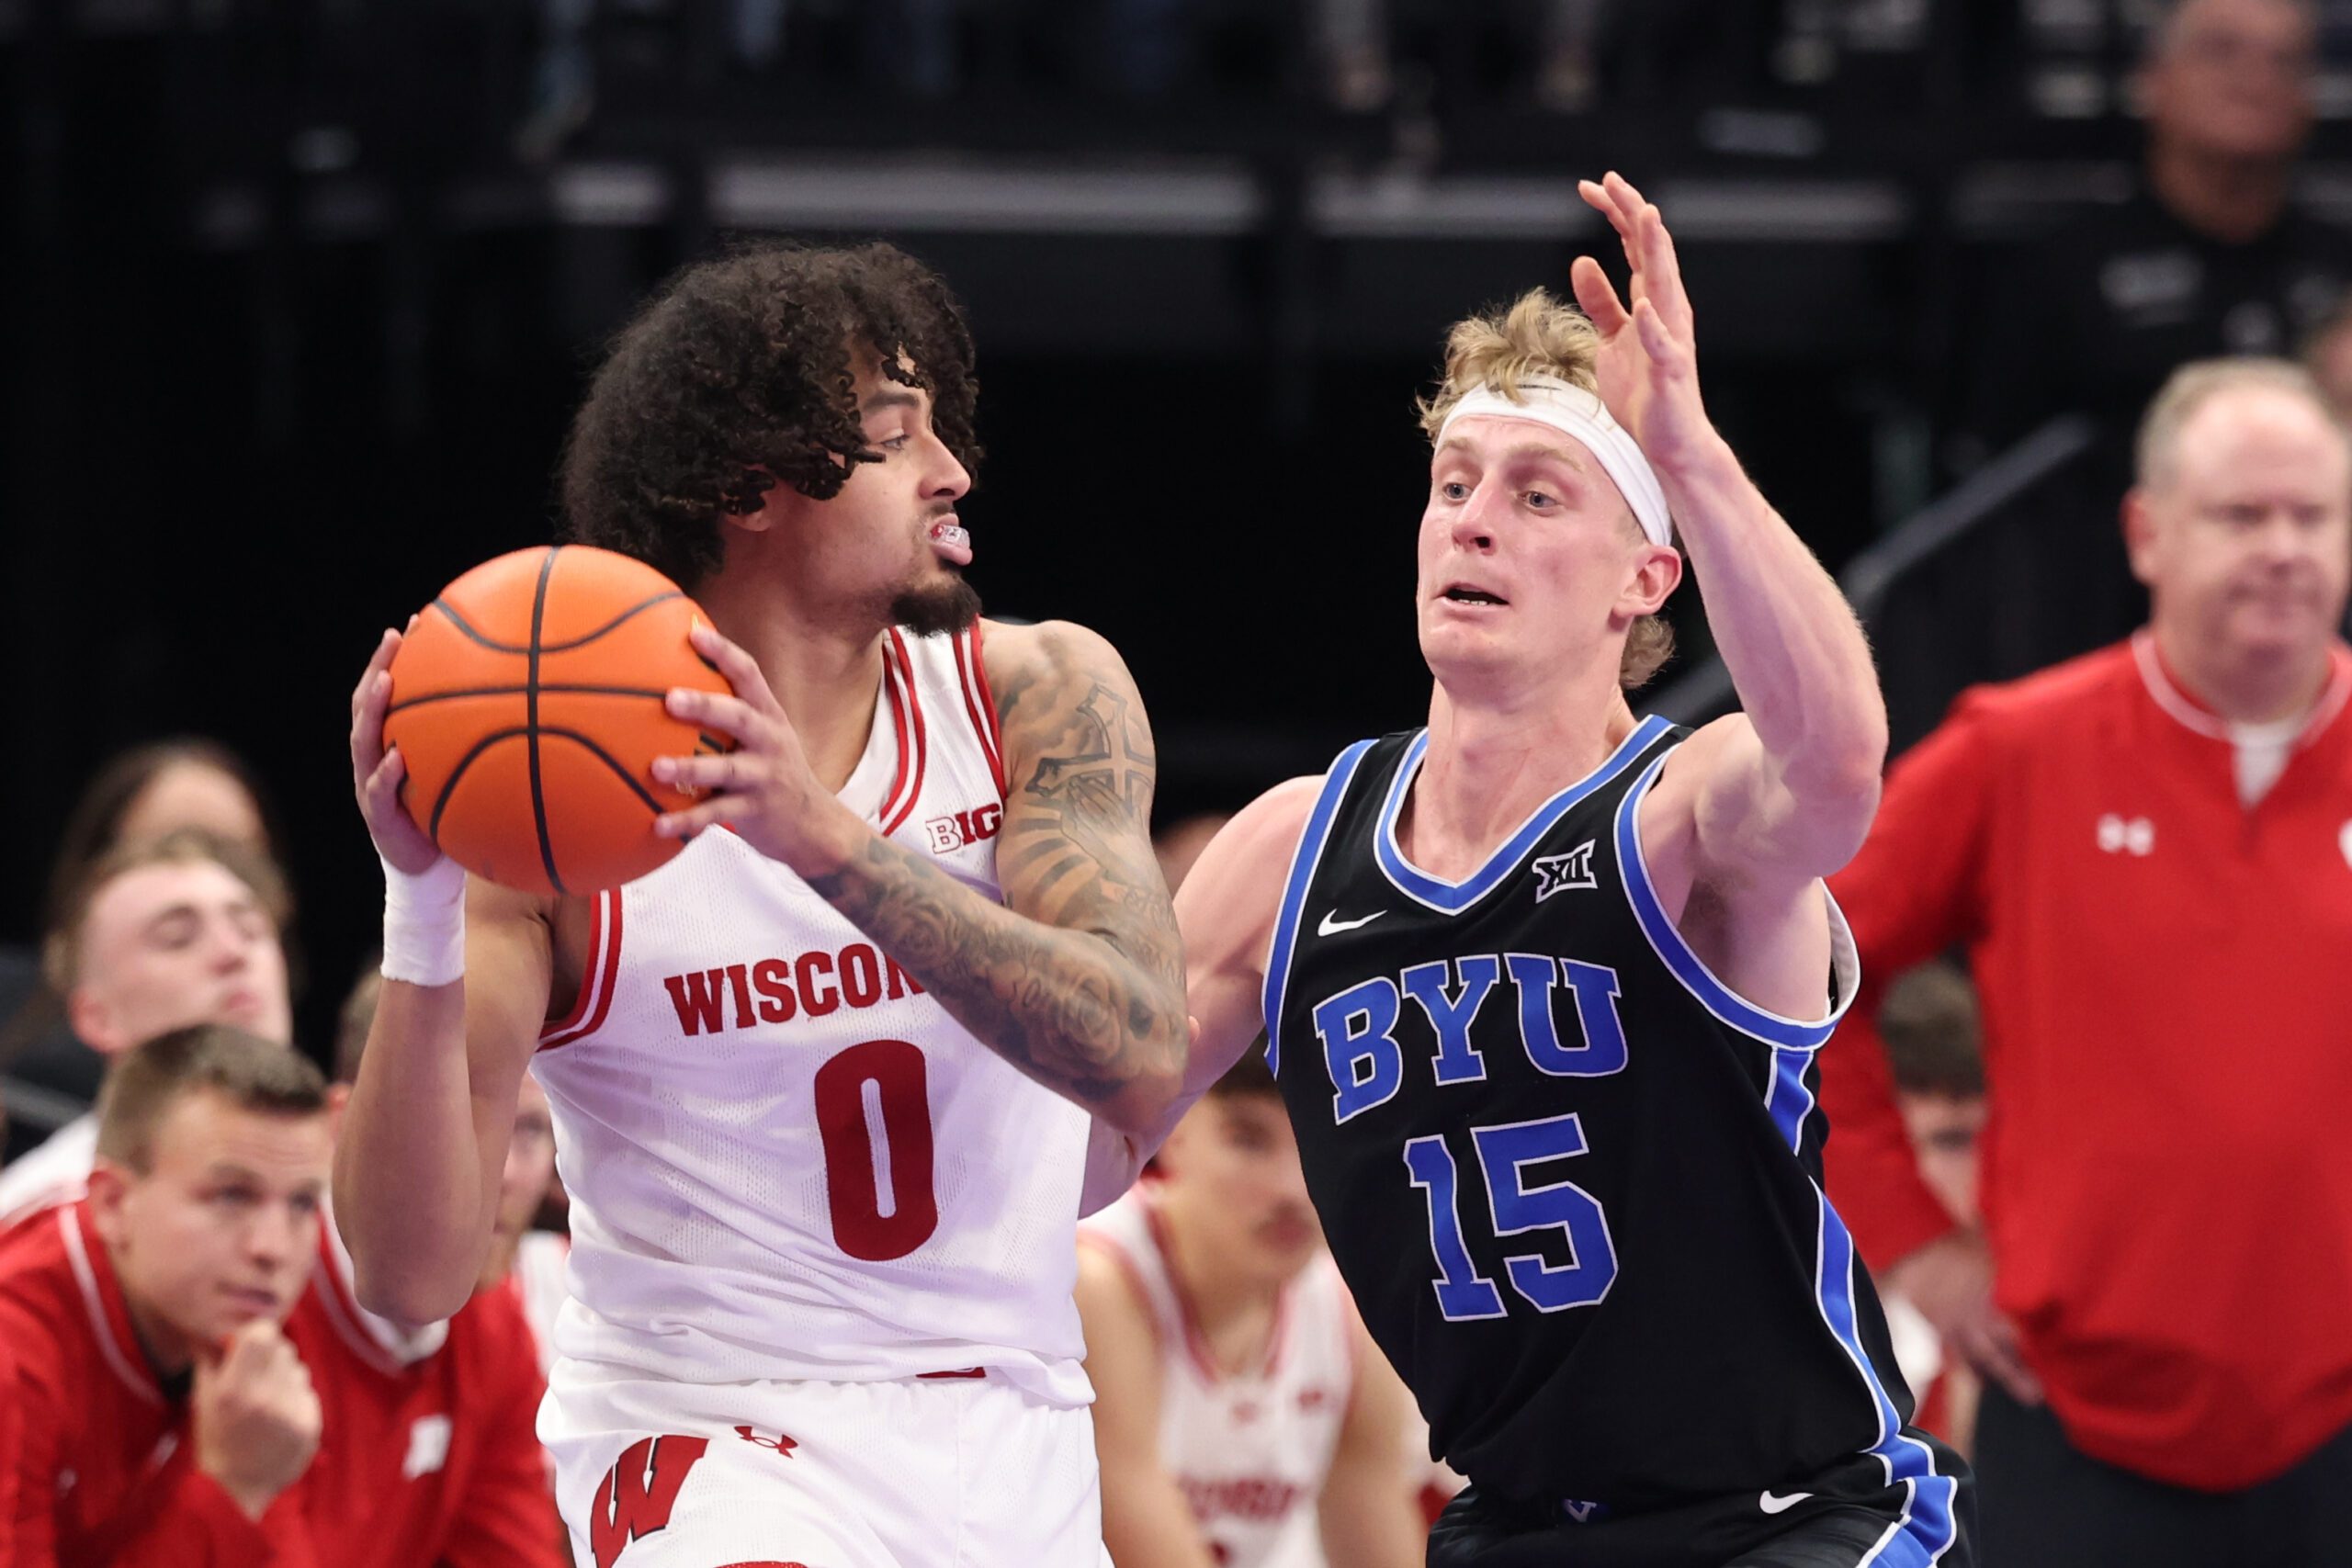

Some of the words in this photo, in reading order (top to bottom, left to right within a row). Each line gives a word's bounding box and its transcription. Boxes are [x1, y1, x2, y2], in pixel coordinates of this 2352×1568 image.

[1312, 953, 1629, 1125] BYU
[814, 1039, 939, 1261] 0
[1403, 1112, 1619, 1321] 15
[591, 1435, 710, 1568] W
